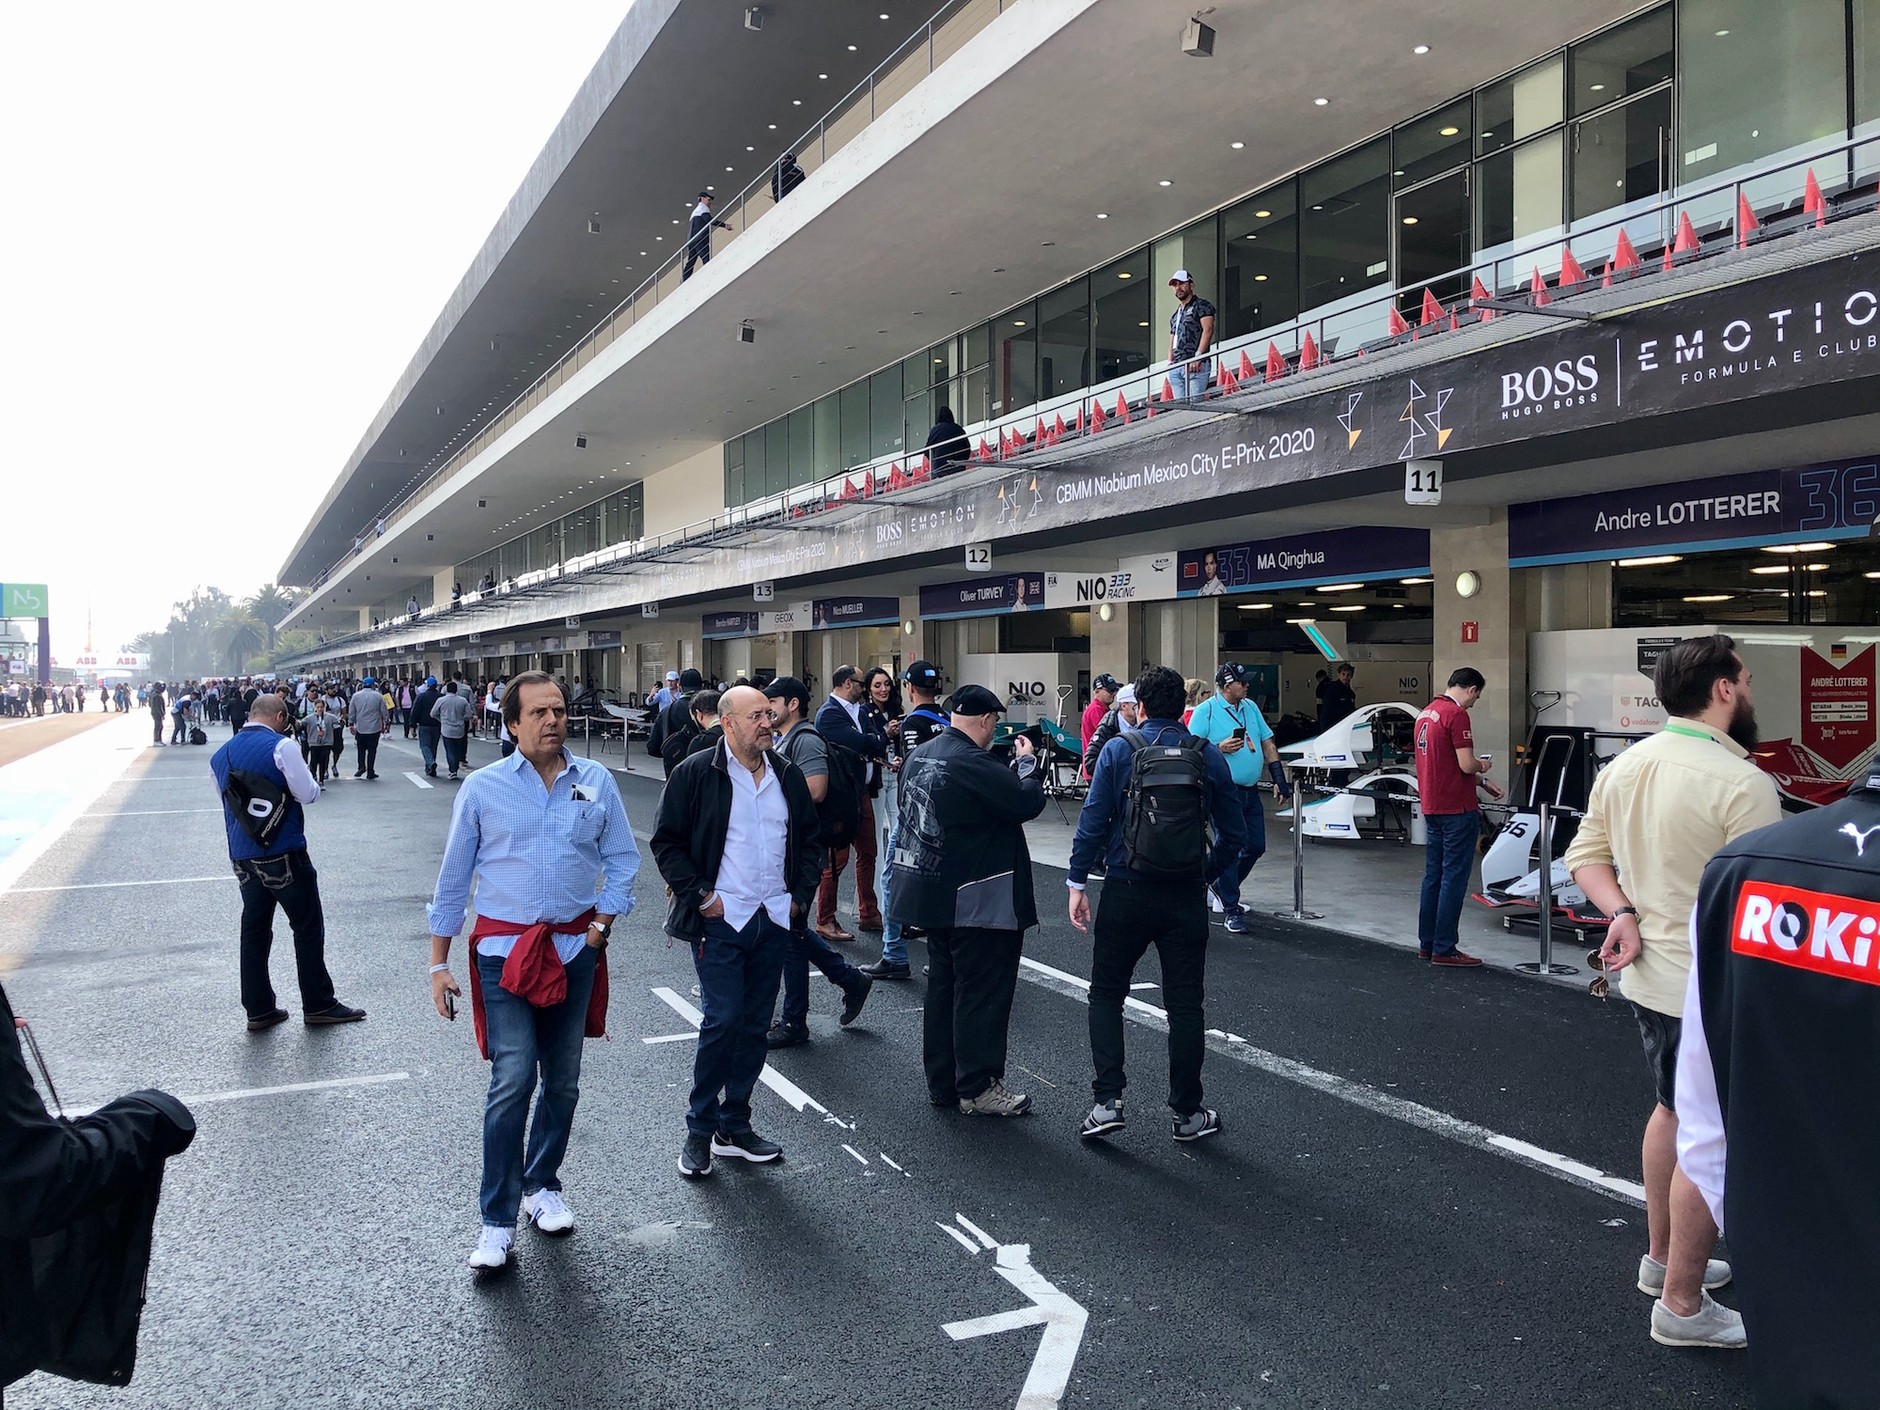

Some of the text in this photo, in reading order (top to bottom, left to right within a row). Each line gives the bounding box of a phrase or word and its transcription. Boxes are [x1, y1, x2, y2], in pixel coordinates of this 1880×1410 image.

[1681, 335, 1877, 385] FORMULA E CLUB
[1501, 355, 1599, 408] BOSS
[1502, 393, 1598, 420] HUGO BOSS
[1056, 427, 1315, 504] CBMM Niobium Mexico City E-Prix 2020
[1411, 469, 1439, 493] 11
[1800, 464, 1880, 531] 36
[911, 503, 975, 532] EMOTION
[1594, 491, 1781, 532] Andre LOTTERER
[876, 521, 902, 543] BOSS
[811, 542, 826, 557] 2020
[968, 549, 989, 563] 12
[1257, 553, 1276, 570] MA
[1278, 549, 1325, 570] Qinghua
[1110, 573, 1131, 587] 333
[756, 586, 772, 596] 13
[960, 586, 1004, 602] Oliver TURVEY
[1077, 577, 1106, 602] NIO
[1107, 586, 1135, 598] RACING
[644, 605, 657, 614] 14
[842, 602, 864, 615] MUELLER
[568, 618, 579, 626] 15
[774, 612, 794, 623] GEOX
[76, 657, 97, 665] ABB
[116, 657, 137, 665] ABB
[1399, 677, 1419, 688] NIO
[1811, 675, 1868, 687] ANDRÉ LOTTERER
[1009, 682, 1045, 697] NIO
[1632, 718, 1660, 726] vodafone
[1417, 721, 1429, 755] 4
[1314, 785, 1349, 794] PORSCHE
